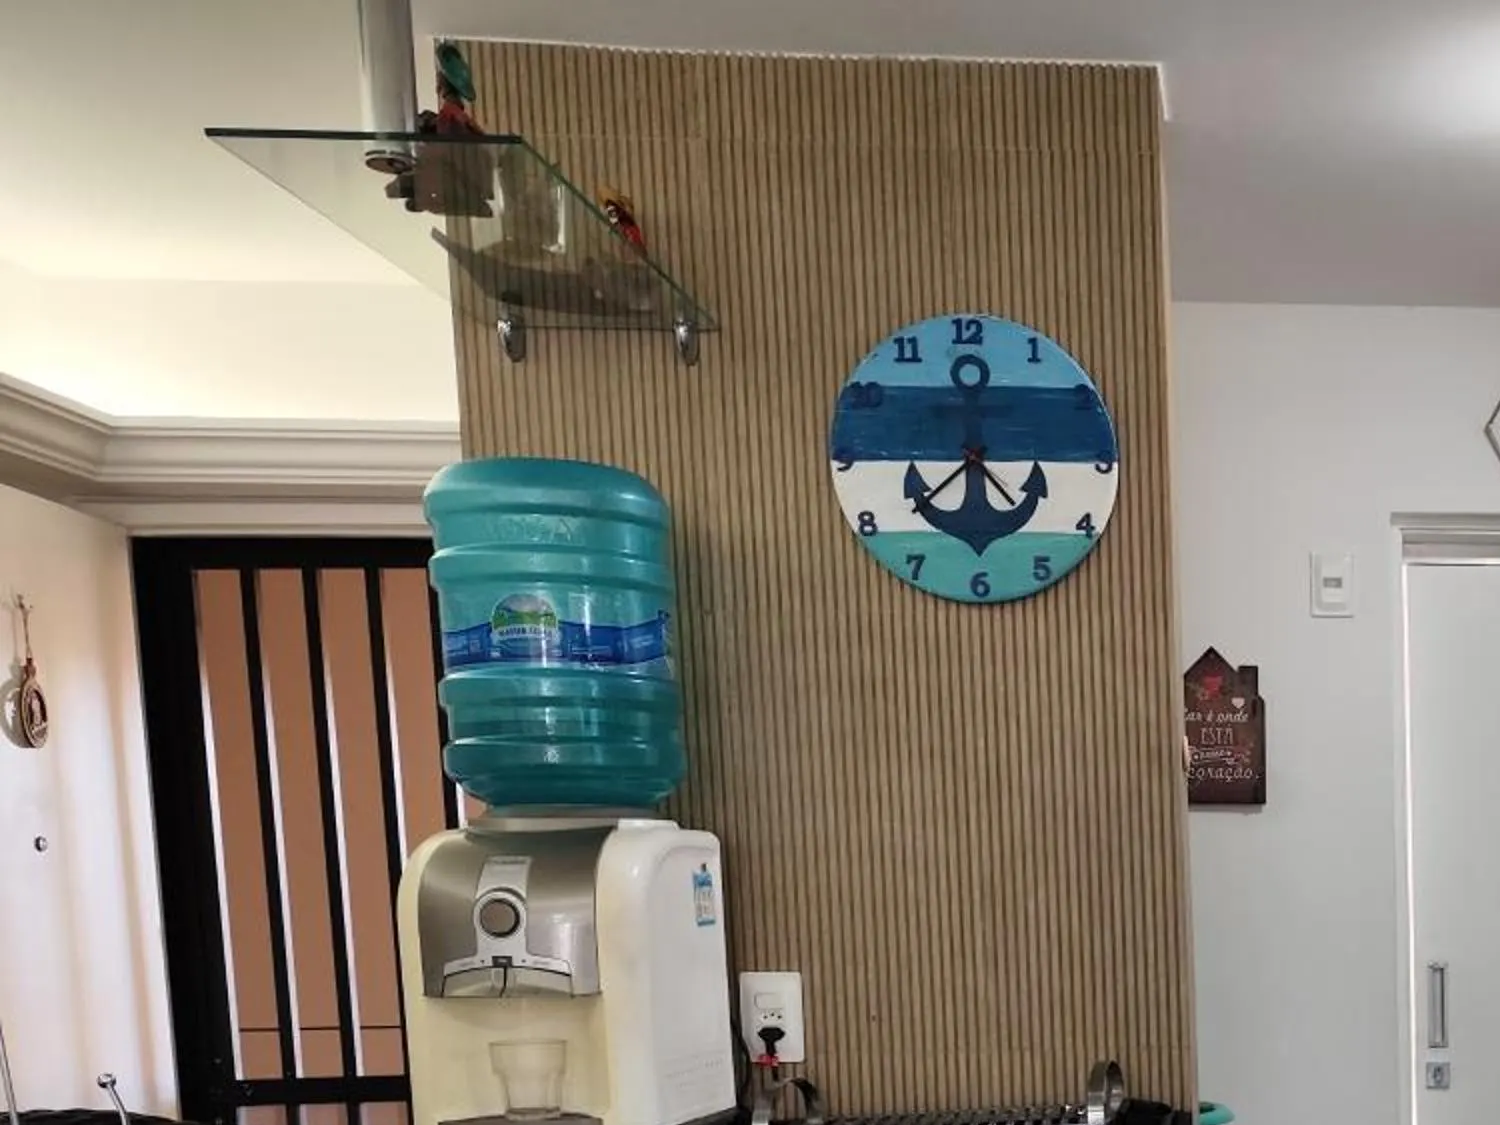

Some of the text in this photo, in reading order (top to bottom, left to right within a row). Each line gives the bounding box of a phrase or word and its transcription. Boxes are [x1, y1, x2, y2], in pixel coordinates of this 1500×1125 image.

[951, 318, 983, 345] 12
[893, 337, 922, 363] 11
[1027, 337, 1041, 363] 1
[858, 511, 878, 536] 8
[1076, 513, 1095, 538] 4
[906, 554, 926, 580] 7
[1033, 556, 1051, 582] 5
[970, 572, 990, 597] 6
